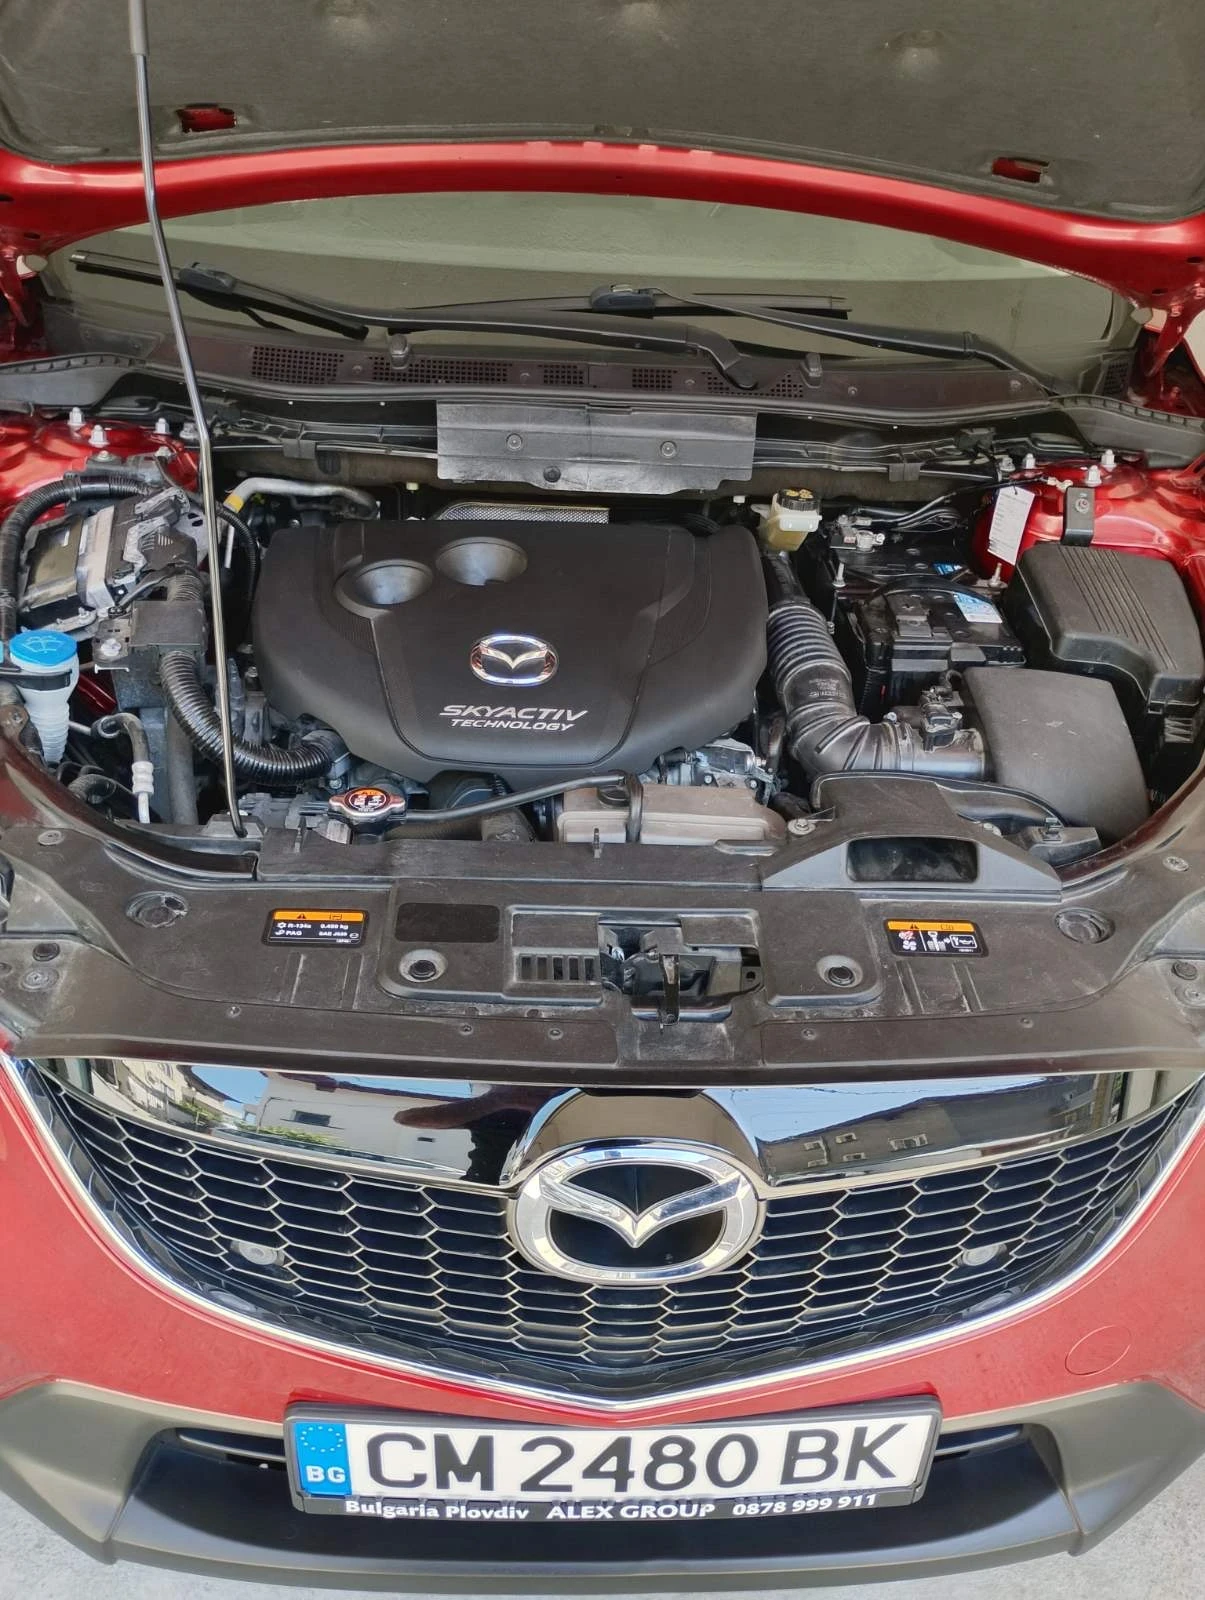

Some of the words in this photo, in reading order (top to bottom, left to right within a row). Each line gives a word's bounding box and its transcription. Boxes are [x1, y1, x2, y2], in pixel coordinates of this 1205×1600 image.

[440, 704, 588, 721] SKYACTIV
[451, 719, 576, 731] TECHNOLOGY
[366, 1431, 495, 1492] CM
[520, 1432, 760, 1492] 2480
[780, 1423, 909, 1486] BK
[305, 1465, 346, 1484] BG
[345, 1500, 440, 1519] Bulgaria
[446, 1505, 529, 1520] Plovdiv
[546, 1506, 614, 1520] ALEX
[620, 1503, 716, 1519] GROUP
[732, 1501, 787, 1516] 0878
[792, 1497, 833, 1513] 999
[838, 1493, 878, 1508] 911
